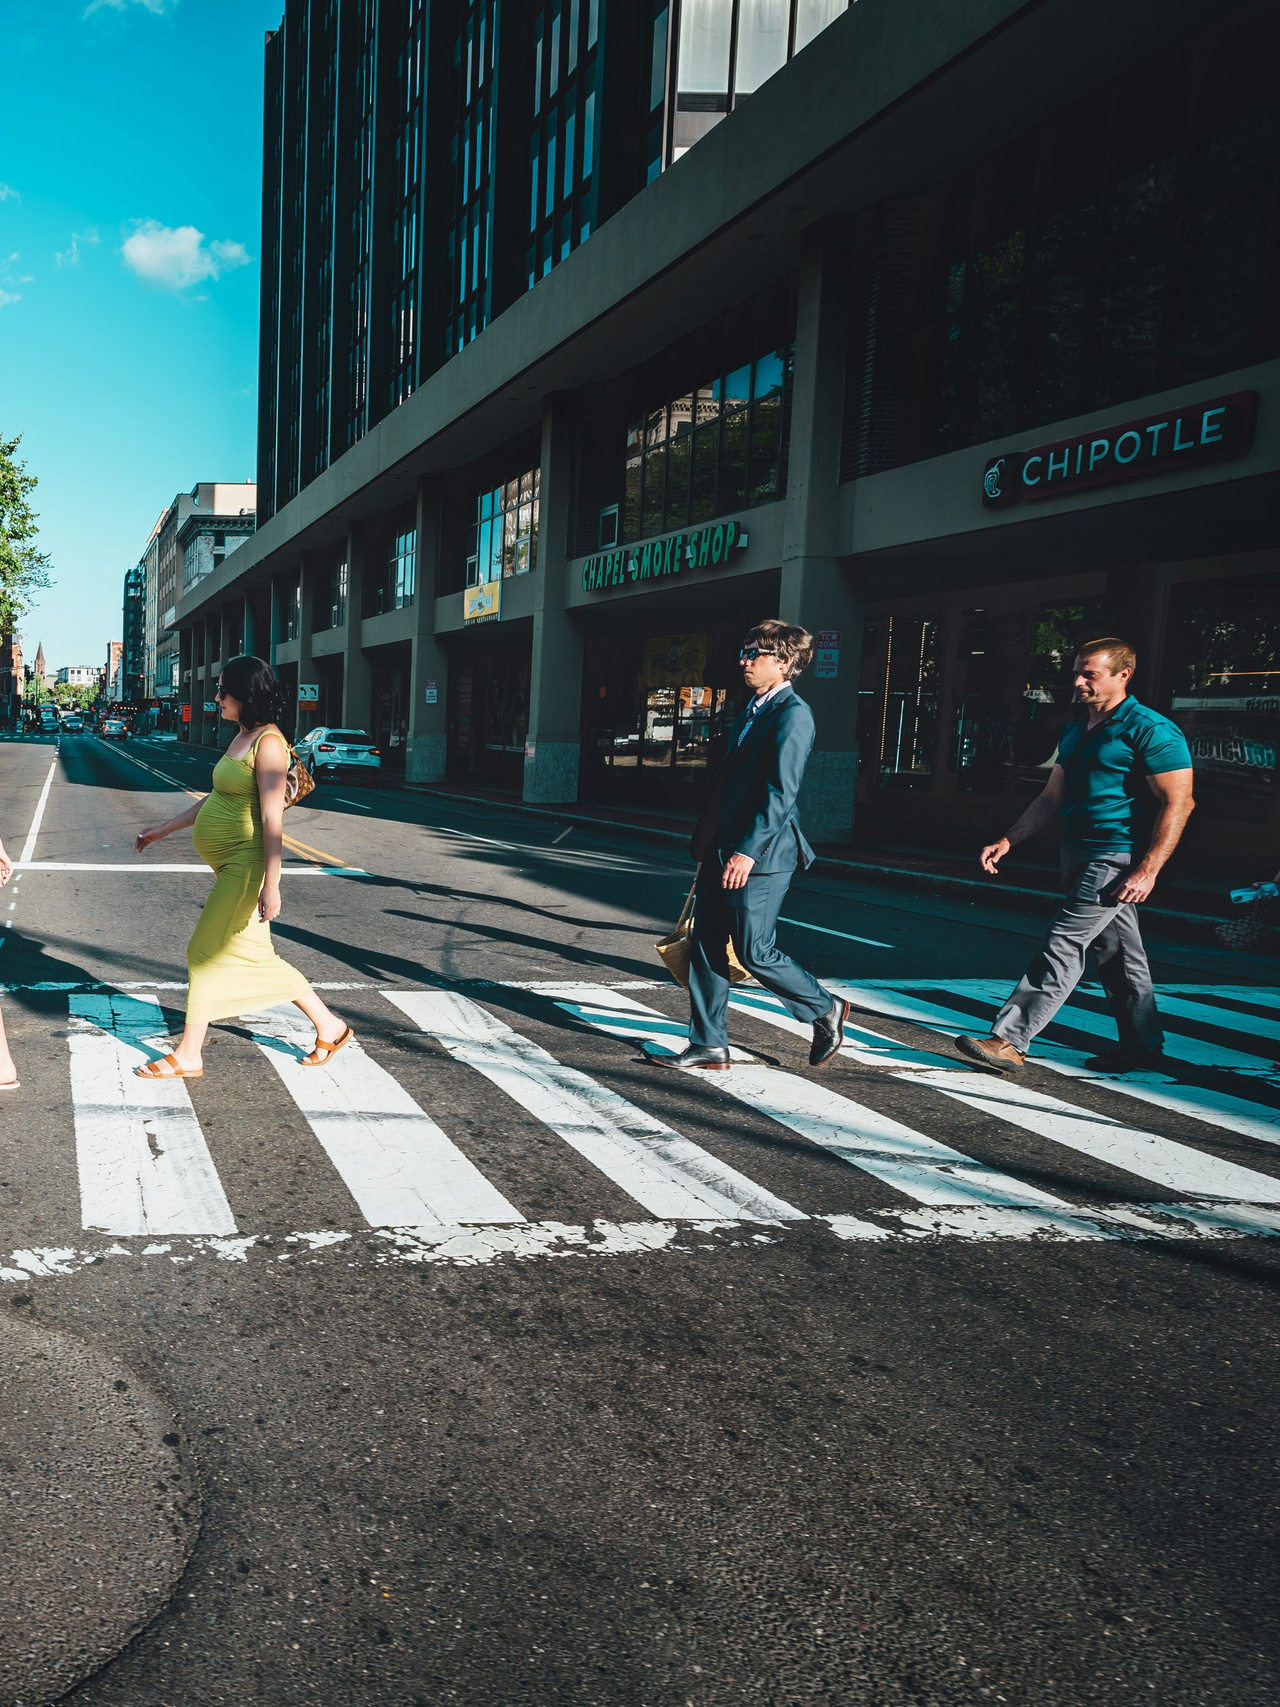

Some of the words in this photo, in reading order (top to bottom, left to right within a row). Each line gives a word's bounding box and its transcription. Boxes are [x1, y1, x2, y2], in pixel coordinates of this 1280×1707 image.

[1022, 406, 1226, 486] CHIPOTLE
[582, 550, 627, 591] CHAPEL
[631, 535, 685, 581] SMOKE
[688, 521, 738, 569] SHOP
